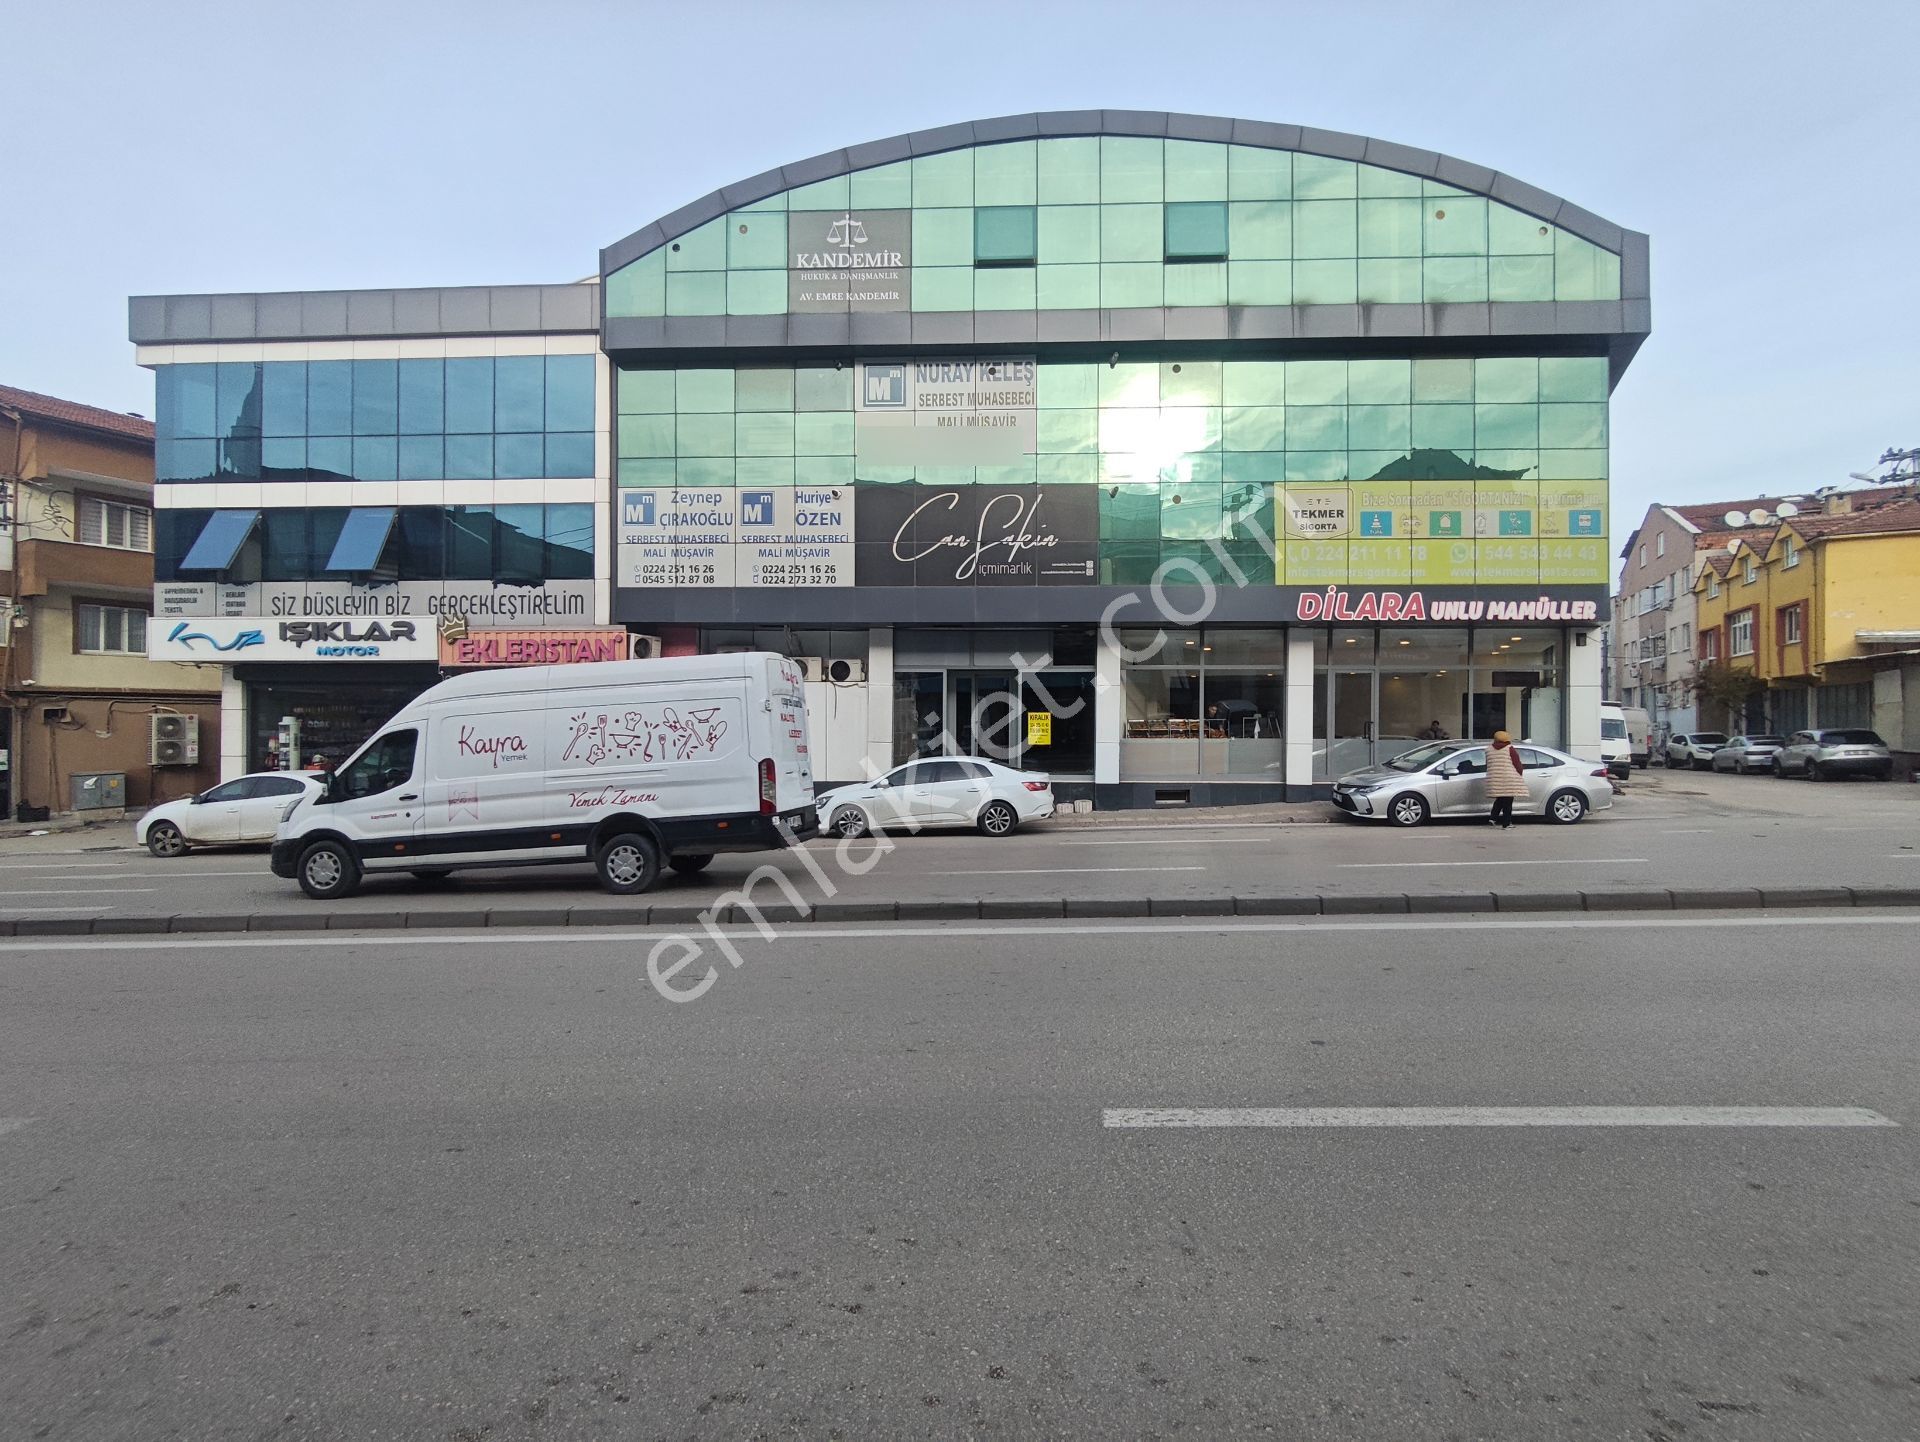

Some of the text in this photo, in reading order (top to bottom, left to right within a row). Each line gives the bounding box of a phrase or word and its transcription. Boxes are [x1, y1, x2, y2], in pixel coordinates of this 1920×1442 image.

[797, 249, 903, 268] KANDEMİR
[840, 272, 898, 281] DANIŞMANLIK
[816, 292, 844, 301] EMRE
[846, 290, 900, 300] KANDEMİR
[916, 361, 1034, 386] NURAY KELEŞ
[919, 388, 1035, 406] SERBEST MUHASEBECİ
[671, 490, 722, 507] Zeynep
[795, 490, 831, 507] Huriye
[1362, 491, 1386, 507] Bize
[1387, 490, 1444, 507] Sormadan
[660, 510, 734, 530] ÇIRAKOĞLU
[796, 509, 841, 526] ÖZEN
[1292, 509, 1345, 519] TEKMER
[626, 533, 729, 544] SERBEST MUHASEBECİ
[741, 533, 849, 543] SERBEST MUHASEBECİ
[892, 492, 1059, 580] Can Sakin
[643, 546, 714, 560] MALİ MÜŞAVİR
[758, 546, 830, 560] MALİ MÜŞAVİR
[1301, 545, 1310, 560] 0
[643, 564, 715, 574] 0224 251 16 26
[762, 564, 836, 574] 0224 251 16 26
[978, 561, 1033, 577] içmimarlık
[643, 575, 715, 584] 0545 512 87 08
[762, 575, 837, 584] 0224 273 32 70
[271, 591, 297, 616] SİZ
[385, 591, 411, 616] BİZ
[1296, 584, 1598, 621] DİLARA UNLU MAMÜLLER
[279, 620, 417, 649] IŞIKLAR
[316, 645, 380, 657] MOTOR
[458, 725, 528, 768] Kayra
[501, 753, 528, 762] Yemek
[568, 785, 614, 807] Yemek
